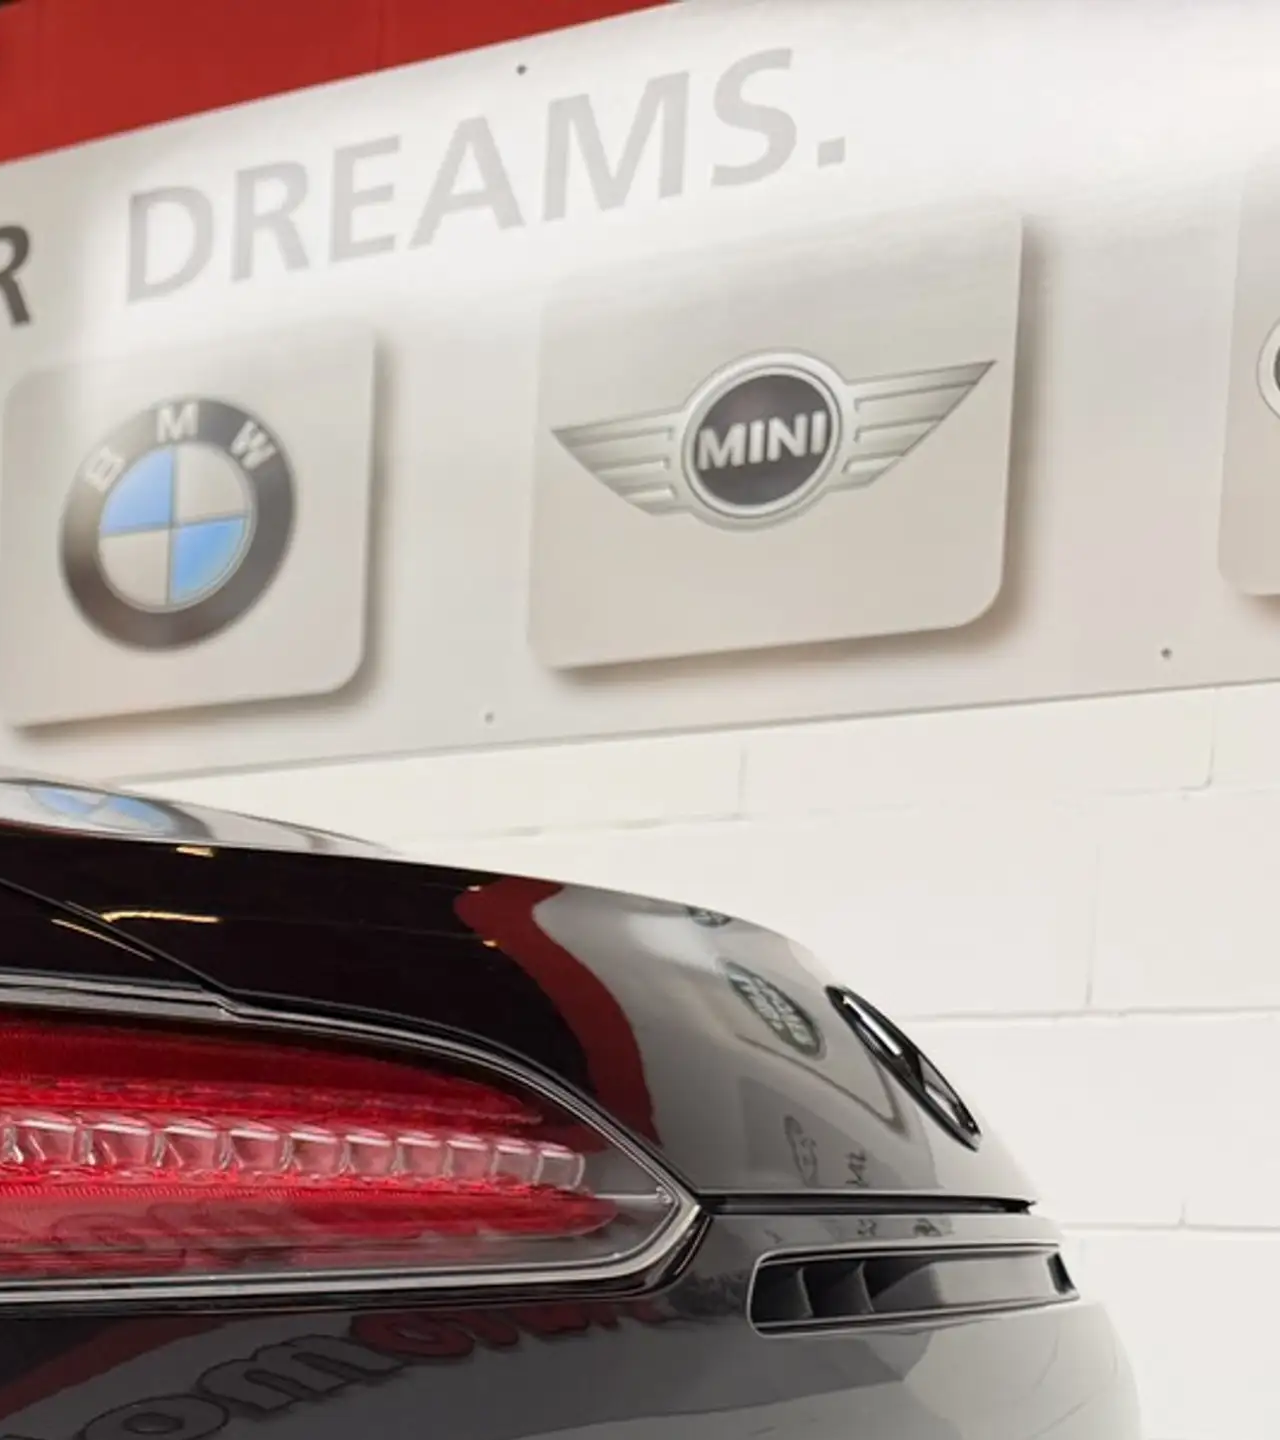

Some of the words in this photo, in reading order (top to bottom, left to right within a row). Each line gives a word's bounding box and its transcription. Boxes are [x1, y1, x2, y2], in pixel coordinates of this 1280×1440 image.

[124, 44, 847, 306] DREAMS.
[83, 402, 277, 492] BMW
[692, 406, 831, 474] MINI
